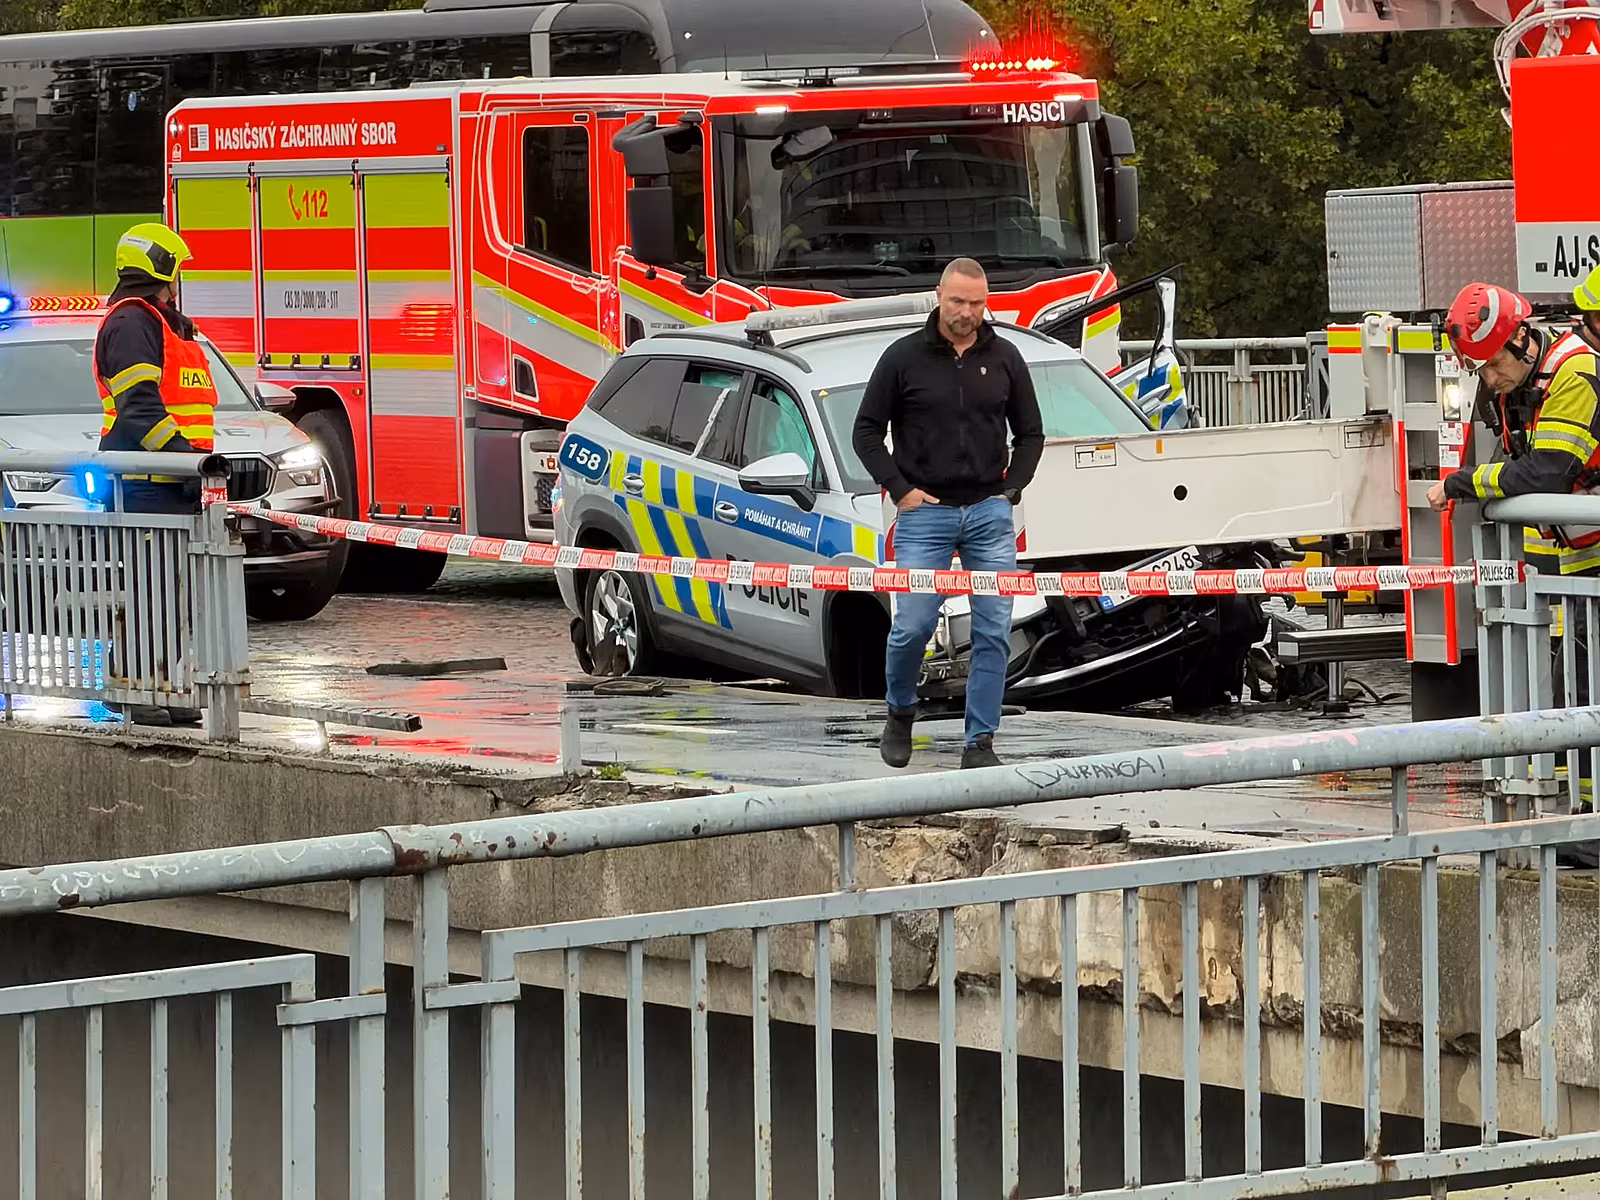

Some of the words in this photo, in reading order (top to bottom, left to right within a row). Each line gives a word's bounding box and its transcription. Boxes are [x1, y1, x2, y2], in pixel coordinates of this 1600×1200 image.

[215, 121, 276, 150] HASIČSKÝ
[280, 118, 358, 148] ZÁCHRANNÝ
[361, 121, 397, 145] SBOR
[302, 189, 328, 218] 112
[568, 442, 601, 471] 158
[744, 508, 776, 528] POMÁHAT
[775, 518, 781, 530] A
[781, 519, 811, 539] CHRÁNIT
[1480, 565, 1503, 581] POLICIE
[1504, 563, 1514, 580] ČR
